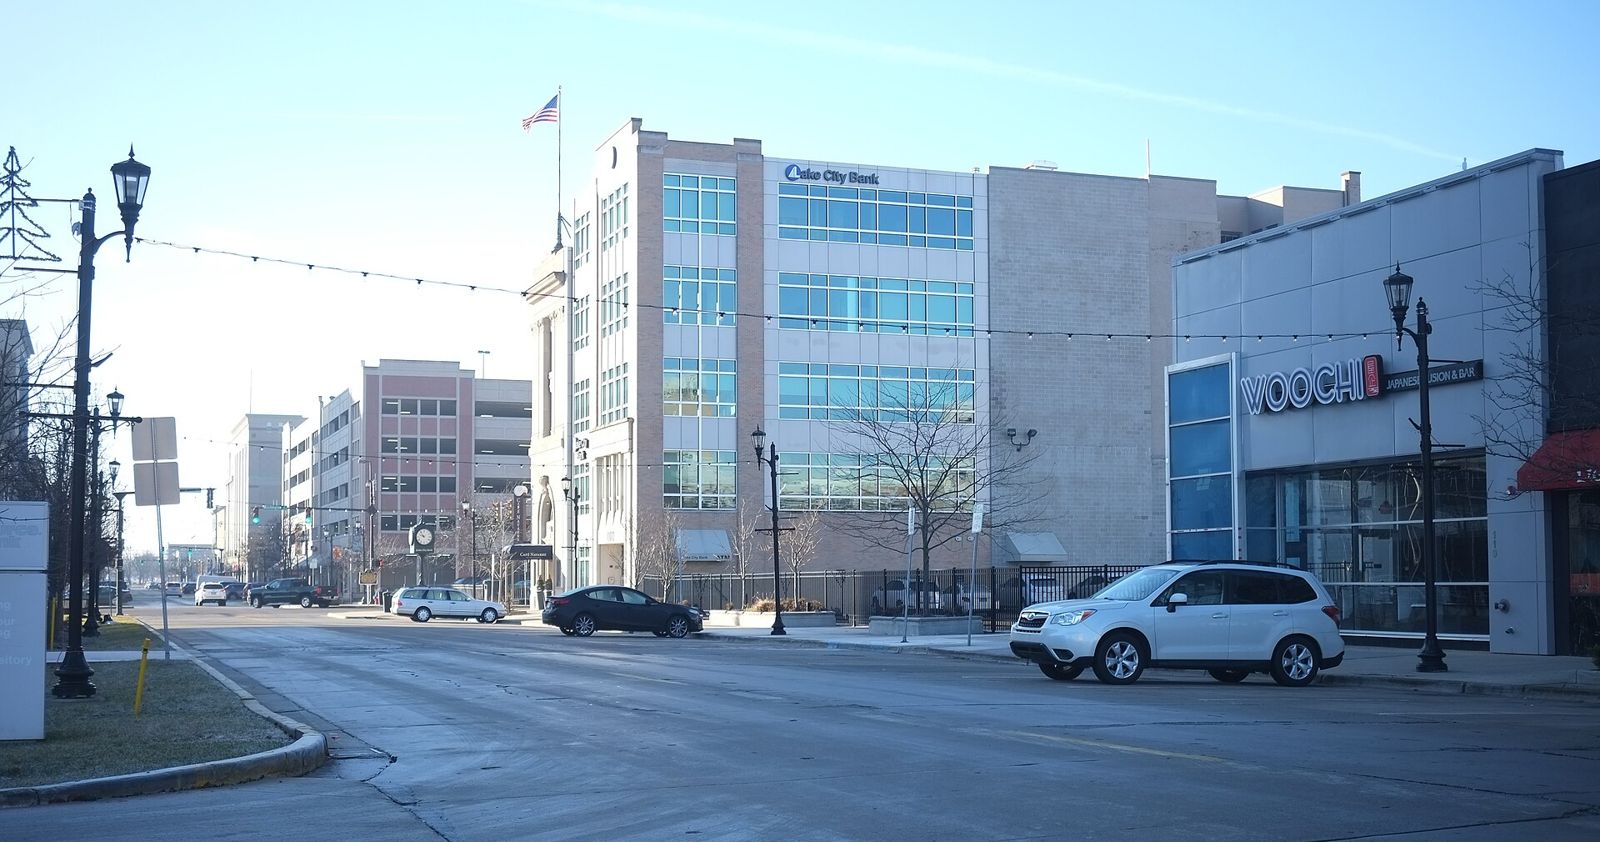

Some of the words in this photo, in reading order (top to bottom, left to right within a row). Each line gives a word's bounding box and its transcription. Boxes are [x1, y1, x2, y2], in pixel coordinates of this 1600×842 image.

[785, 164, 821, 181] Lake
[823, 169, 847, 185] City
[849, 171, 880, 185] Bank
[1240, 357, 1364, 415] WOOCHI
[1428, 370, 1451, 384] USION
[1451, 369, 1458, 380] &
[1459, 367, 1476, 379] BAR
